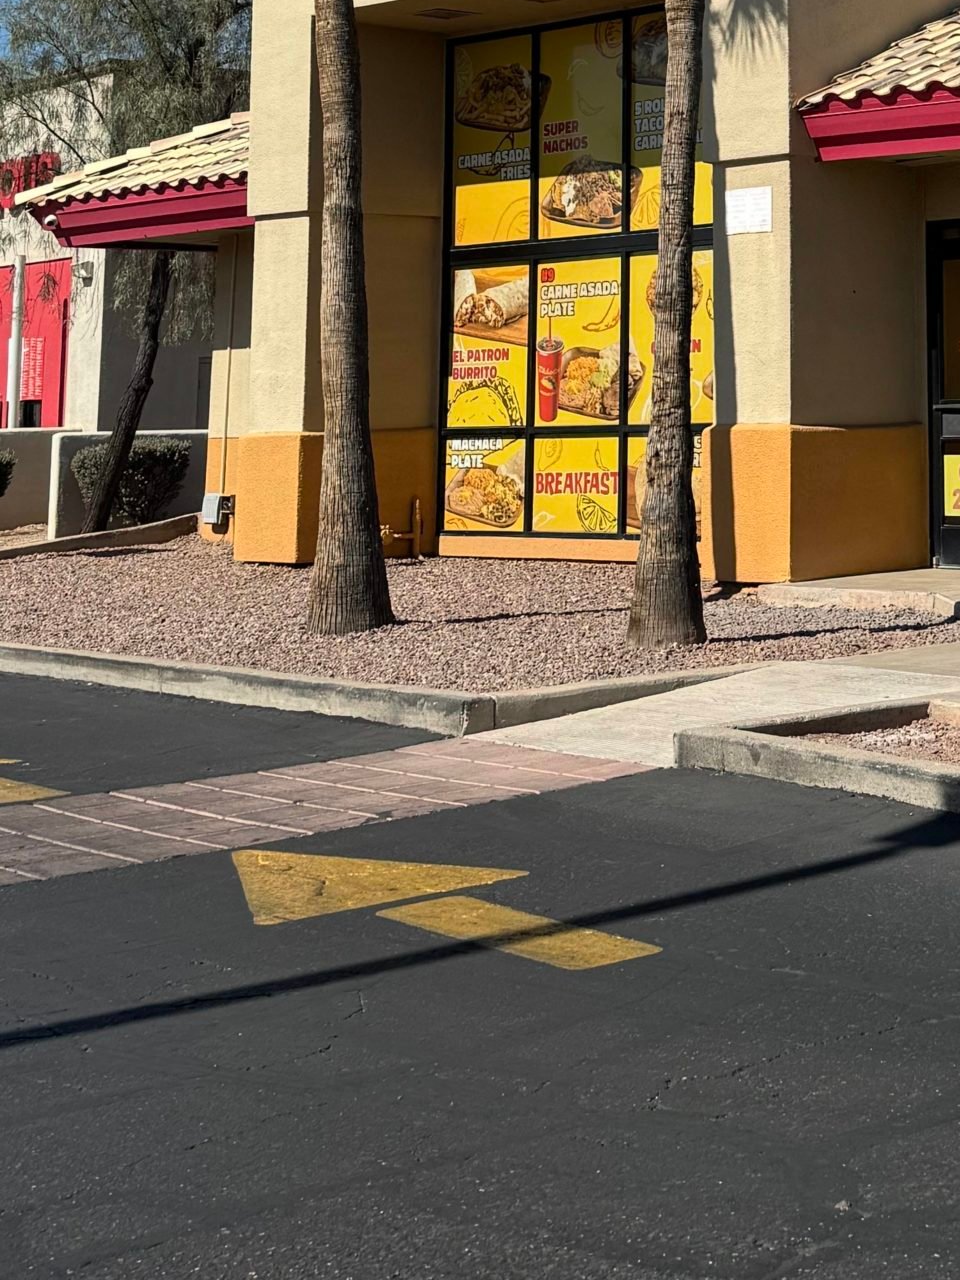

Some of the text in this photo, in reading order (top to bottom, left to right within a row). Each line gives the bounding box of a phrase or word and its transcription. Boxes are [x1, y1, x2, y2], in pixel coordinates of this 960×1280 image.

[634, 101, 642, 116] 5
[543, 120, 579, 137] SUPER
[634, 116, 665, 133] TACO
[543, 136, 588, 154] NACHOS
[458, 147, 531, 169] CARNE ASADA
[500, 165, 531, 180] FRIES
[541, 280, 619, 301] CARNE ASADA
[540, 301, 575, 318] PLATE
[453, 348, 510, 362] EL PATRON
[453, 366, 497, 380] BURRITO
[451, 453, 484, 469] PLATE
[535, 471, 620, 496] BREAKFAST
